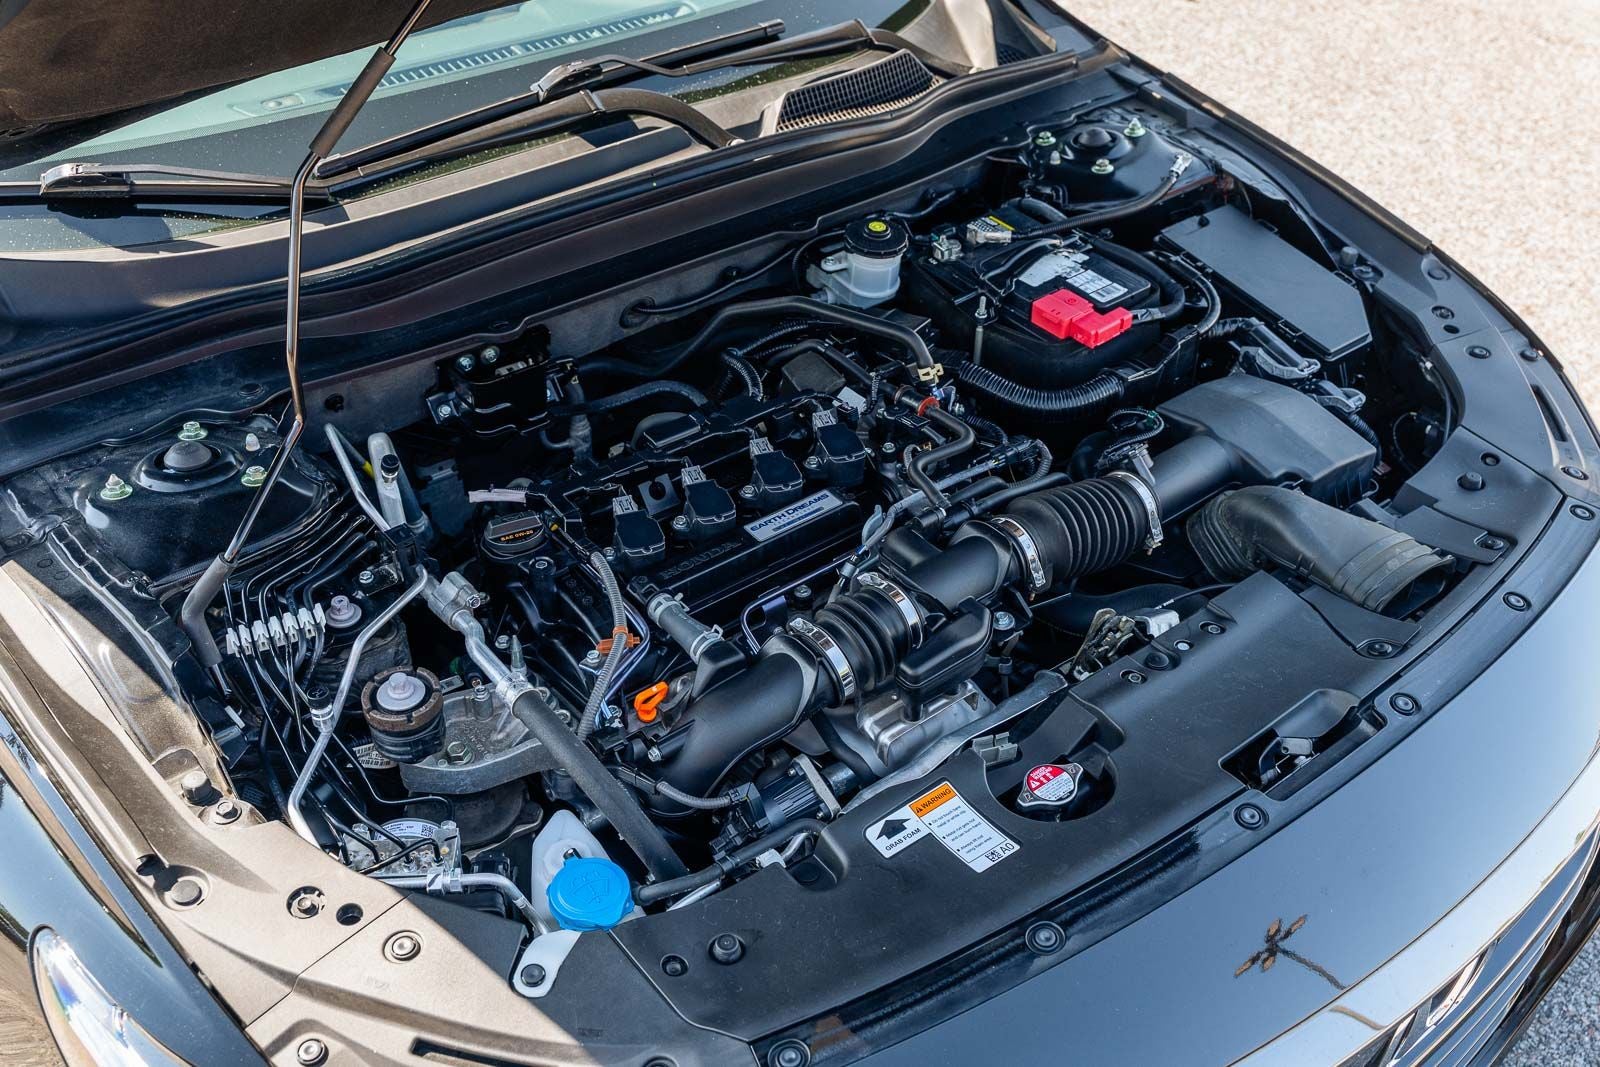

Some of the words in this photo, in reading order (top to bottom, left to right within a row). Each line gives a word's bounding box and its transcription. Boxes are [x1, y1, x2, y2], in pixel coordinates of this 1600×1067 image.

[750, 512, 787, 532] EARTH
[785, 493, 830, 516] DREAMS
[500, 533, 515, 541] SAE
[920, 787, 952, 810] WARNING
[885, 839, 904, 851] GRAB
[902, 827, 922, 841] FOAM
[1000, 842, 1015, 855] A0
